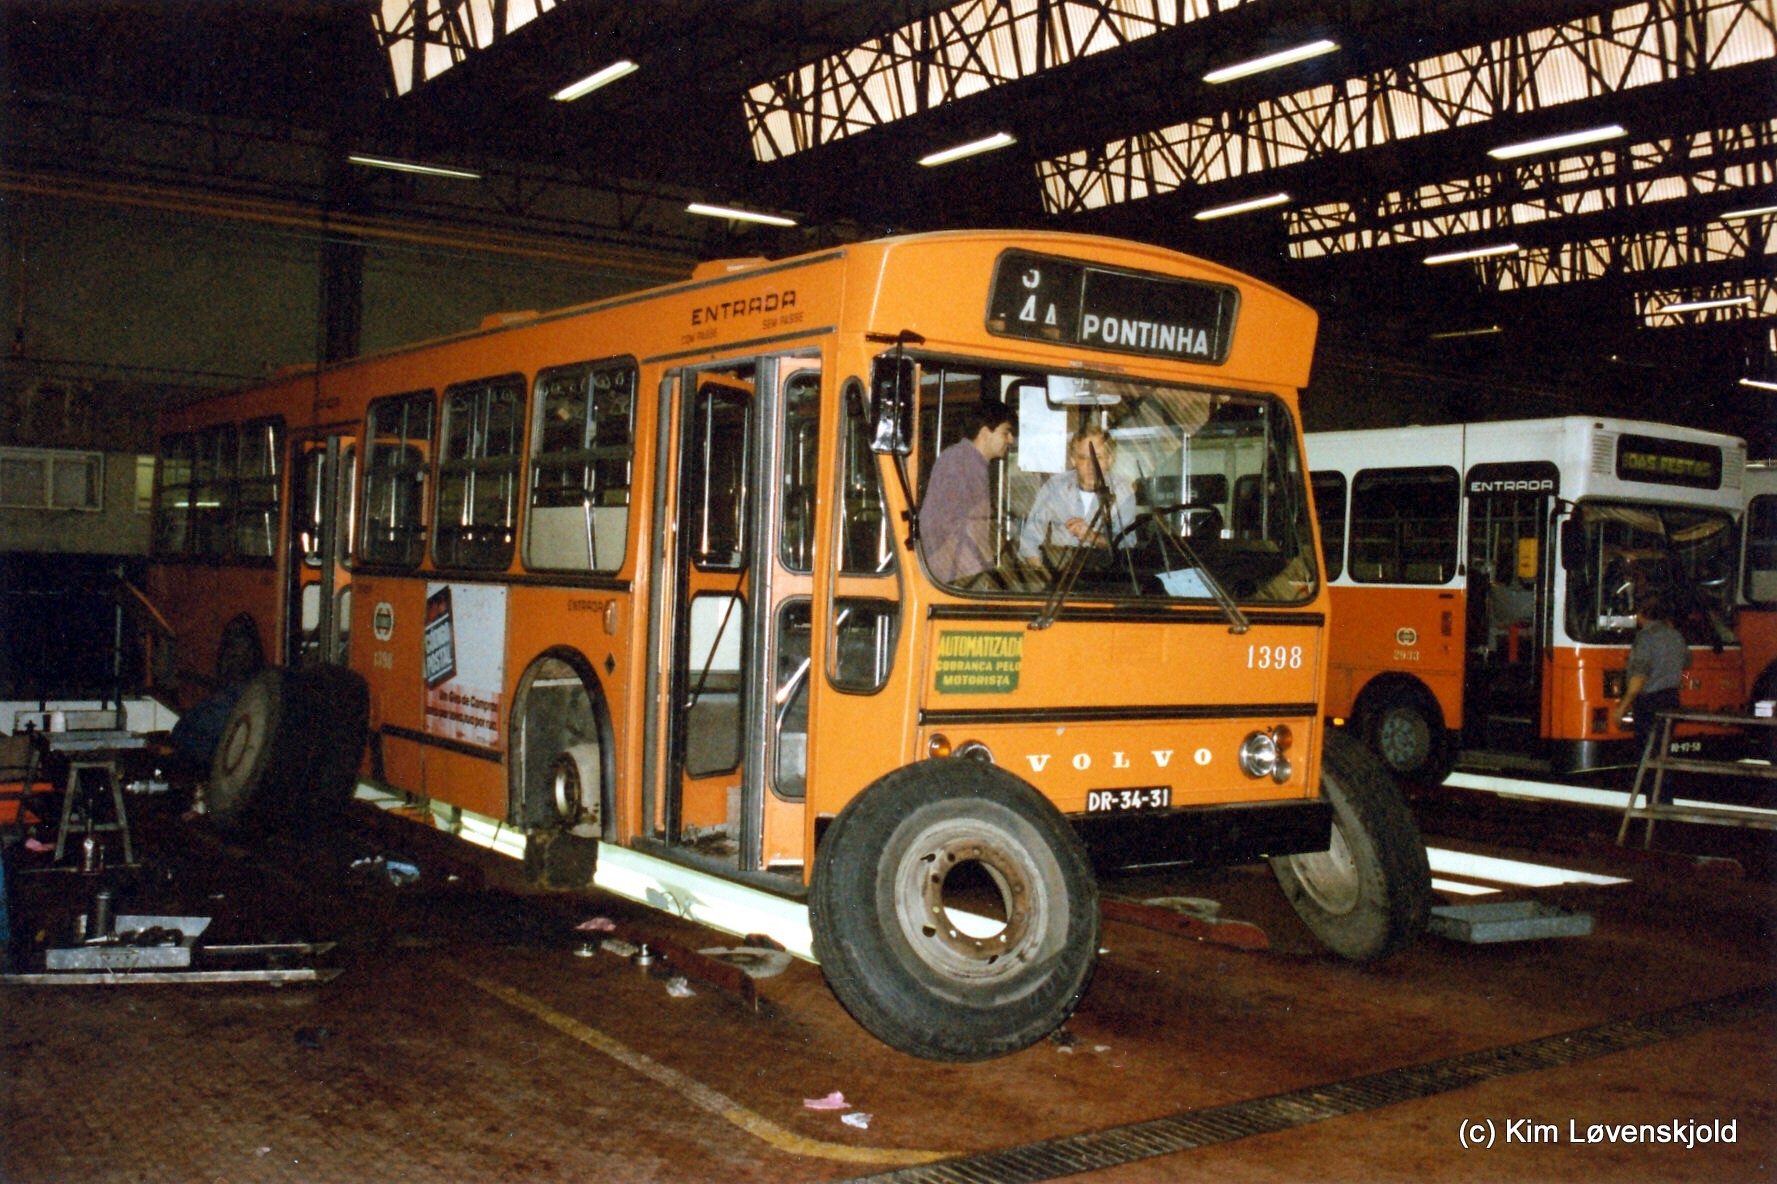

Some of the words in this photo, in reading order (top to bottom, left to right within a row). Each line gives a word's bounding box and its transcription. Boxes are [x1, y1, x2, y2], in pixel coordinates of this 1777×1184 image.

[691, 290, 796, 326] ENTRADA
[1082, 314, 1209, 355] PONTINHA
[1471, 480, 1554, 492] ENTRADA
[1247, 645, 1302, 670] 1398
[943, 675, 1010, 686] MOTORISTA
[1026, 748, 1212, 772] VOLVO
[1088, 788, 1169, 812] DR-34-31
